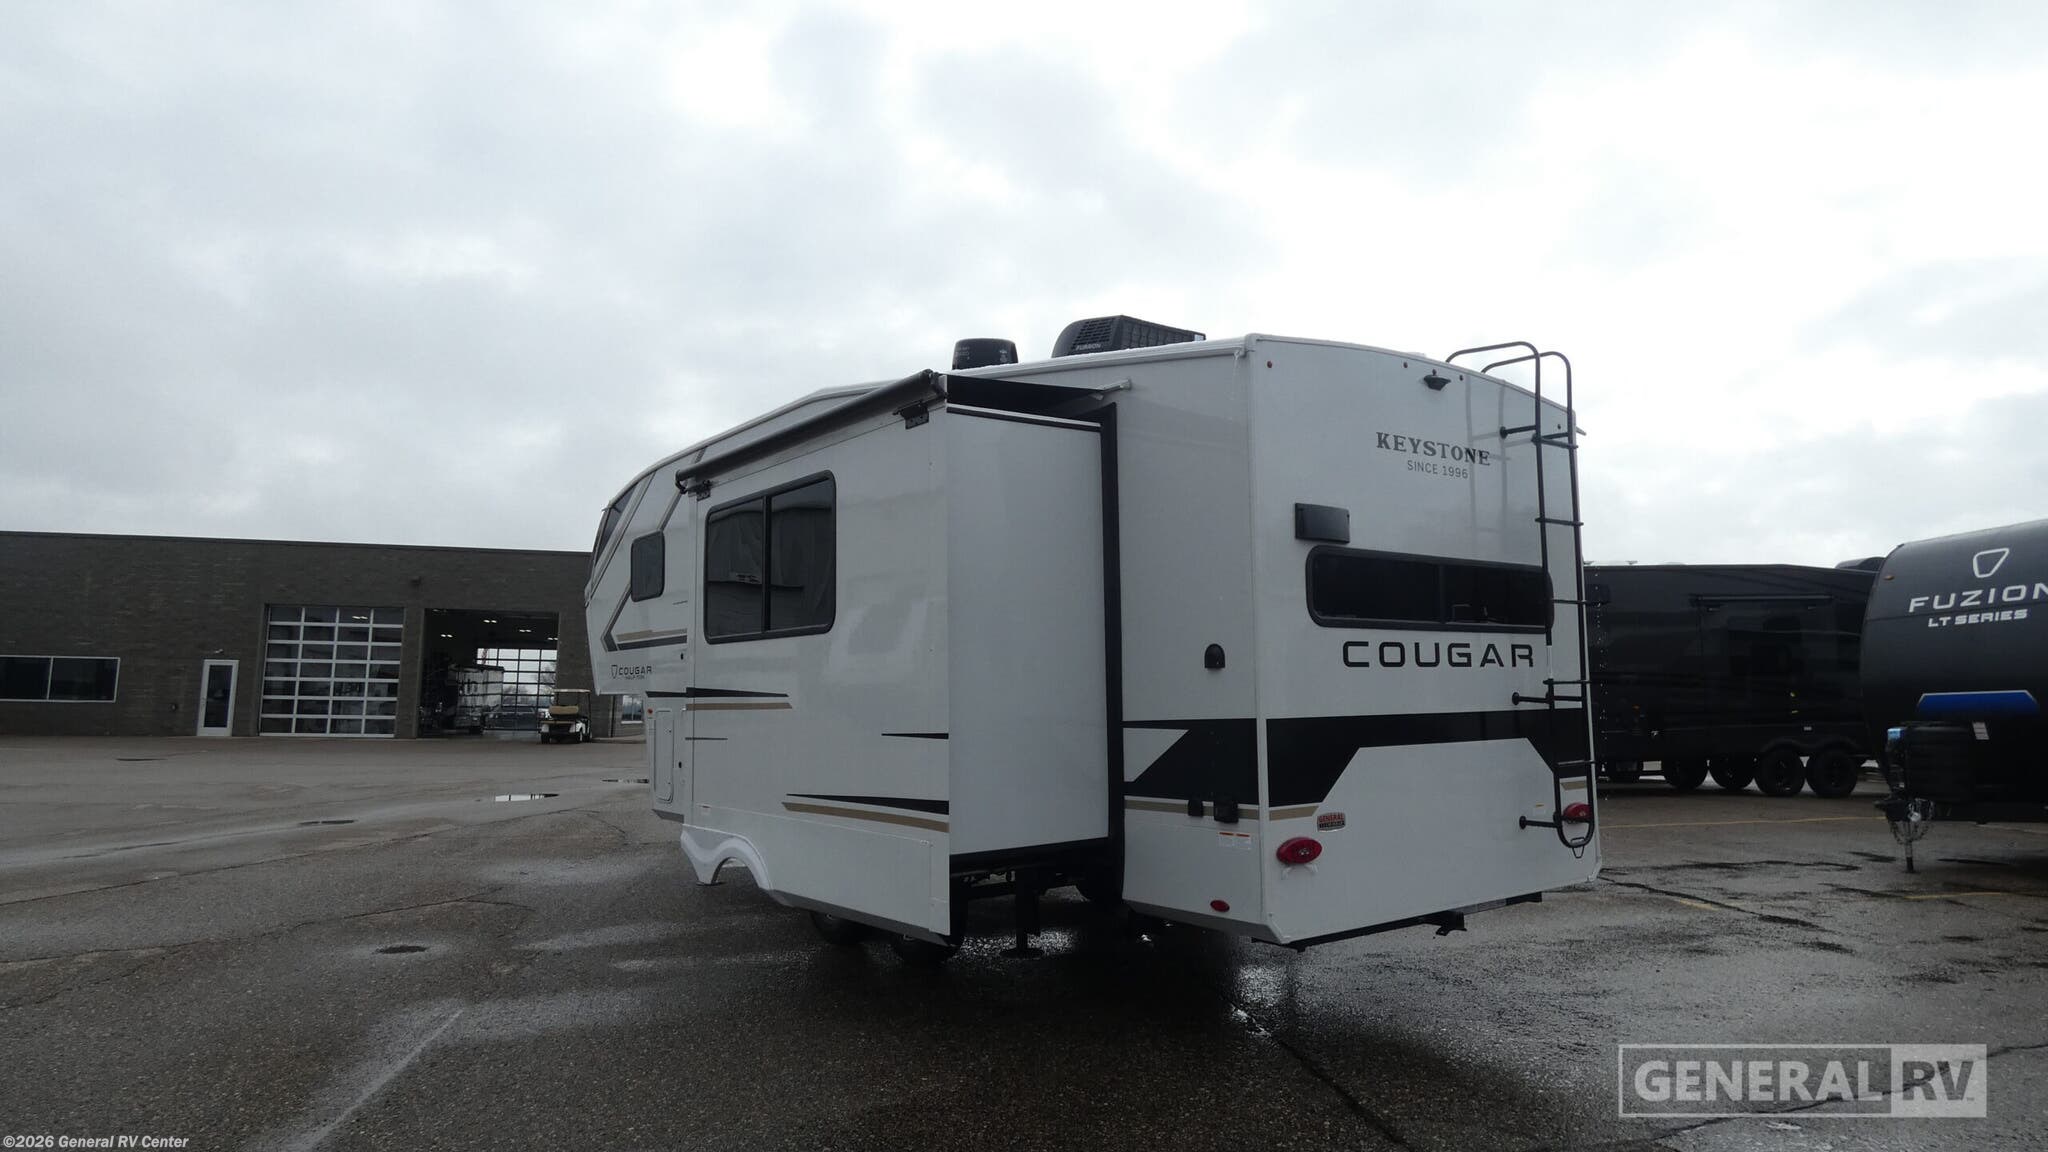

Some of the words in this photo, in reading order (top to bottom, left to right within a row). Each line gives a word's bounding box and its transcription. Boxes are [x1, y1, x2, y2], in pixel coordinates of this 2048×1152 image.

[1376, 431, 1490, 466] KEYSTONE
[1407, 460, 1438, 475] SINCE
[1442, 465, 1469, 479] 1996
[1908, 582, 2048, 613] FUZION
[1928, 616, 1951, 627] LT
[1954, 609, 2028, 625] SERIES
[1343, 641, 1534, 667] COUGAR
[619, 665, 653, 675] COUGAR
